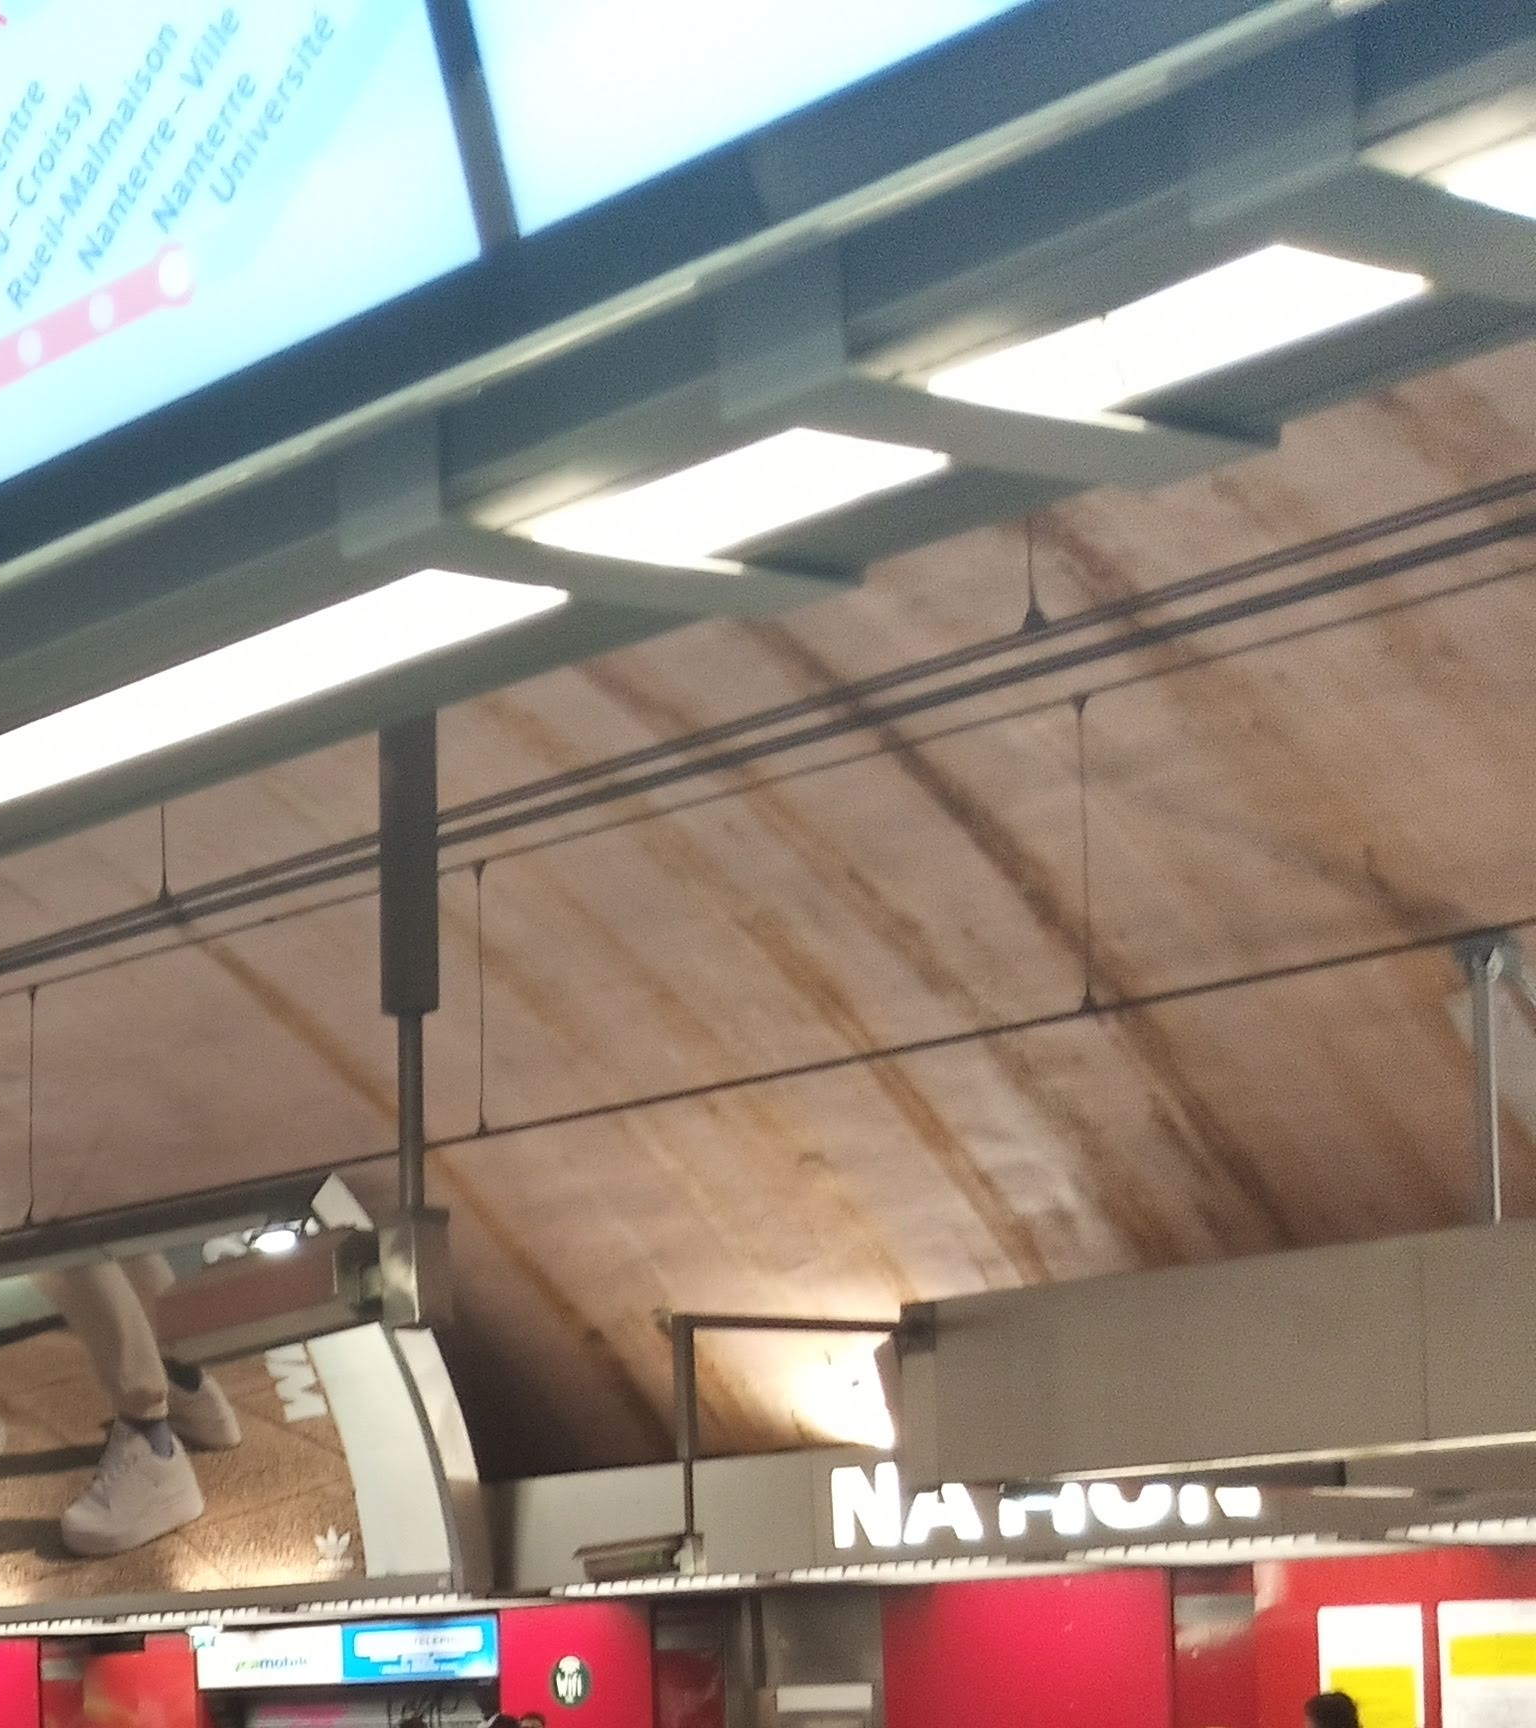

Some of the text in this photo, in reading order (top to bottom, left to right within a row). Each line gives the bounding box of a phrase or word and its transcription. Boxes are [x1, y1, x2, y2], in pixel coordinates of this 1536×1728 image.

[6, 22, 178, 312] Rueil-Malmaison
[15, 83, 92, 208] Croissy
[76, 117, 177, 275] Nanterre
[178, 7, 241, 90] Ville
[150, 72, 257, 235] Nanterre
[209, 6, 336, 204] Université
